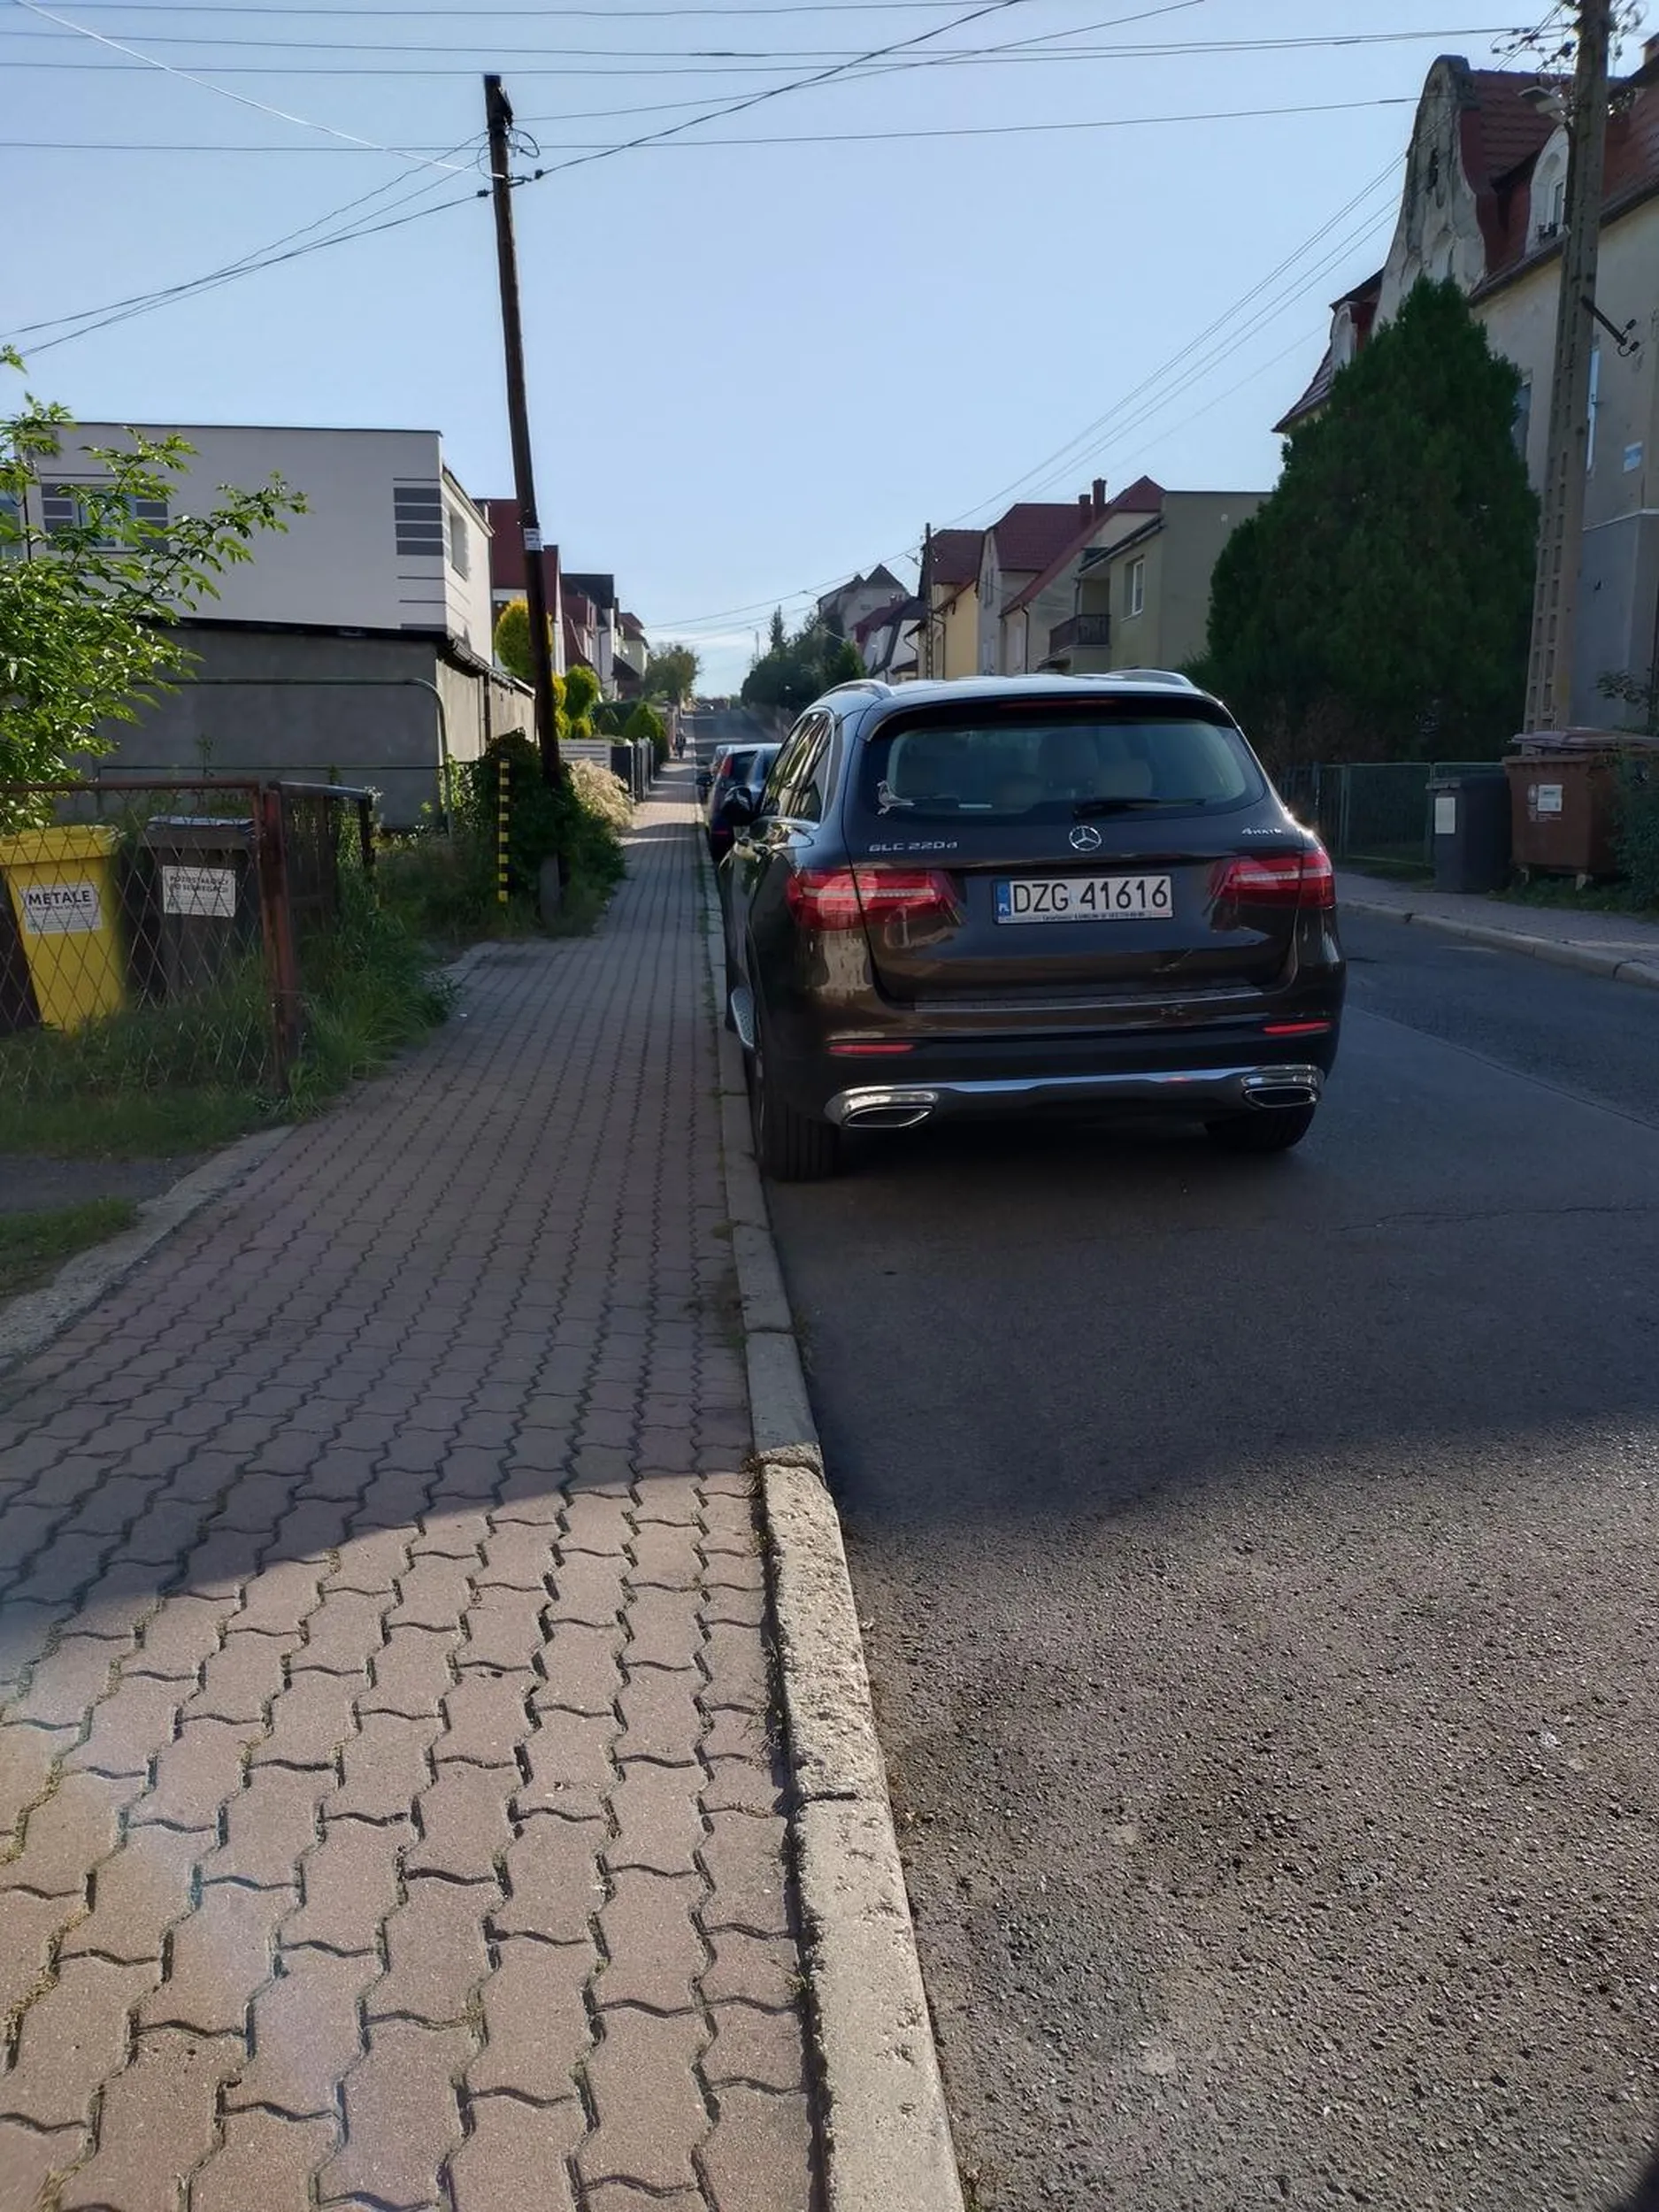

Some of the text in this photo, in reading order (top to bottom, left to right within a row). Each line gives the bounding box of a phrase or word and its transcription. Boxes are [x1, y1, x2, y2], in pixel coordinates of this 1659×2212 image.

[868, 842, 905, 852] GLC
[28, 890, 91, 905] METALE
[1013, 879, 1168, 913] DZG 41616
